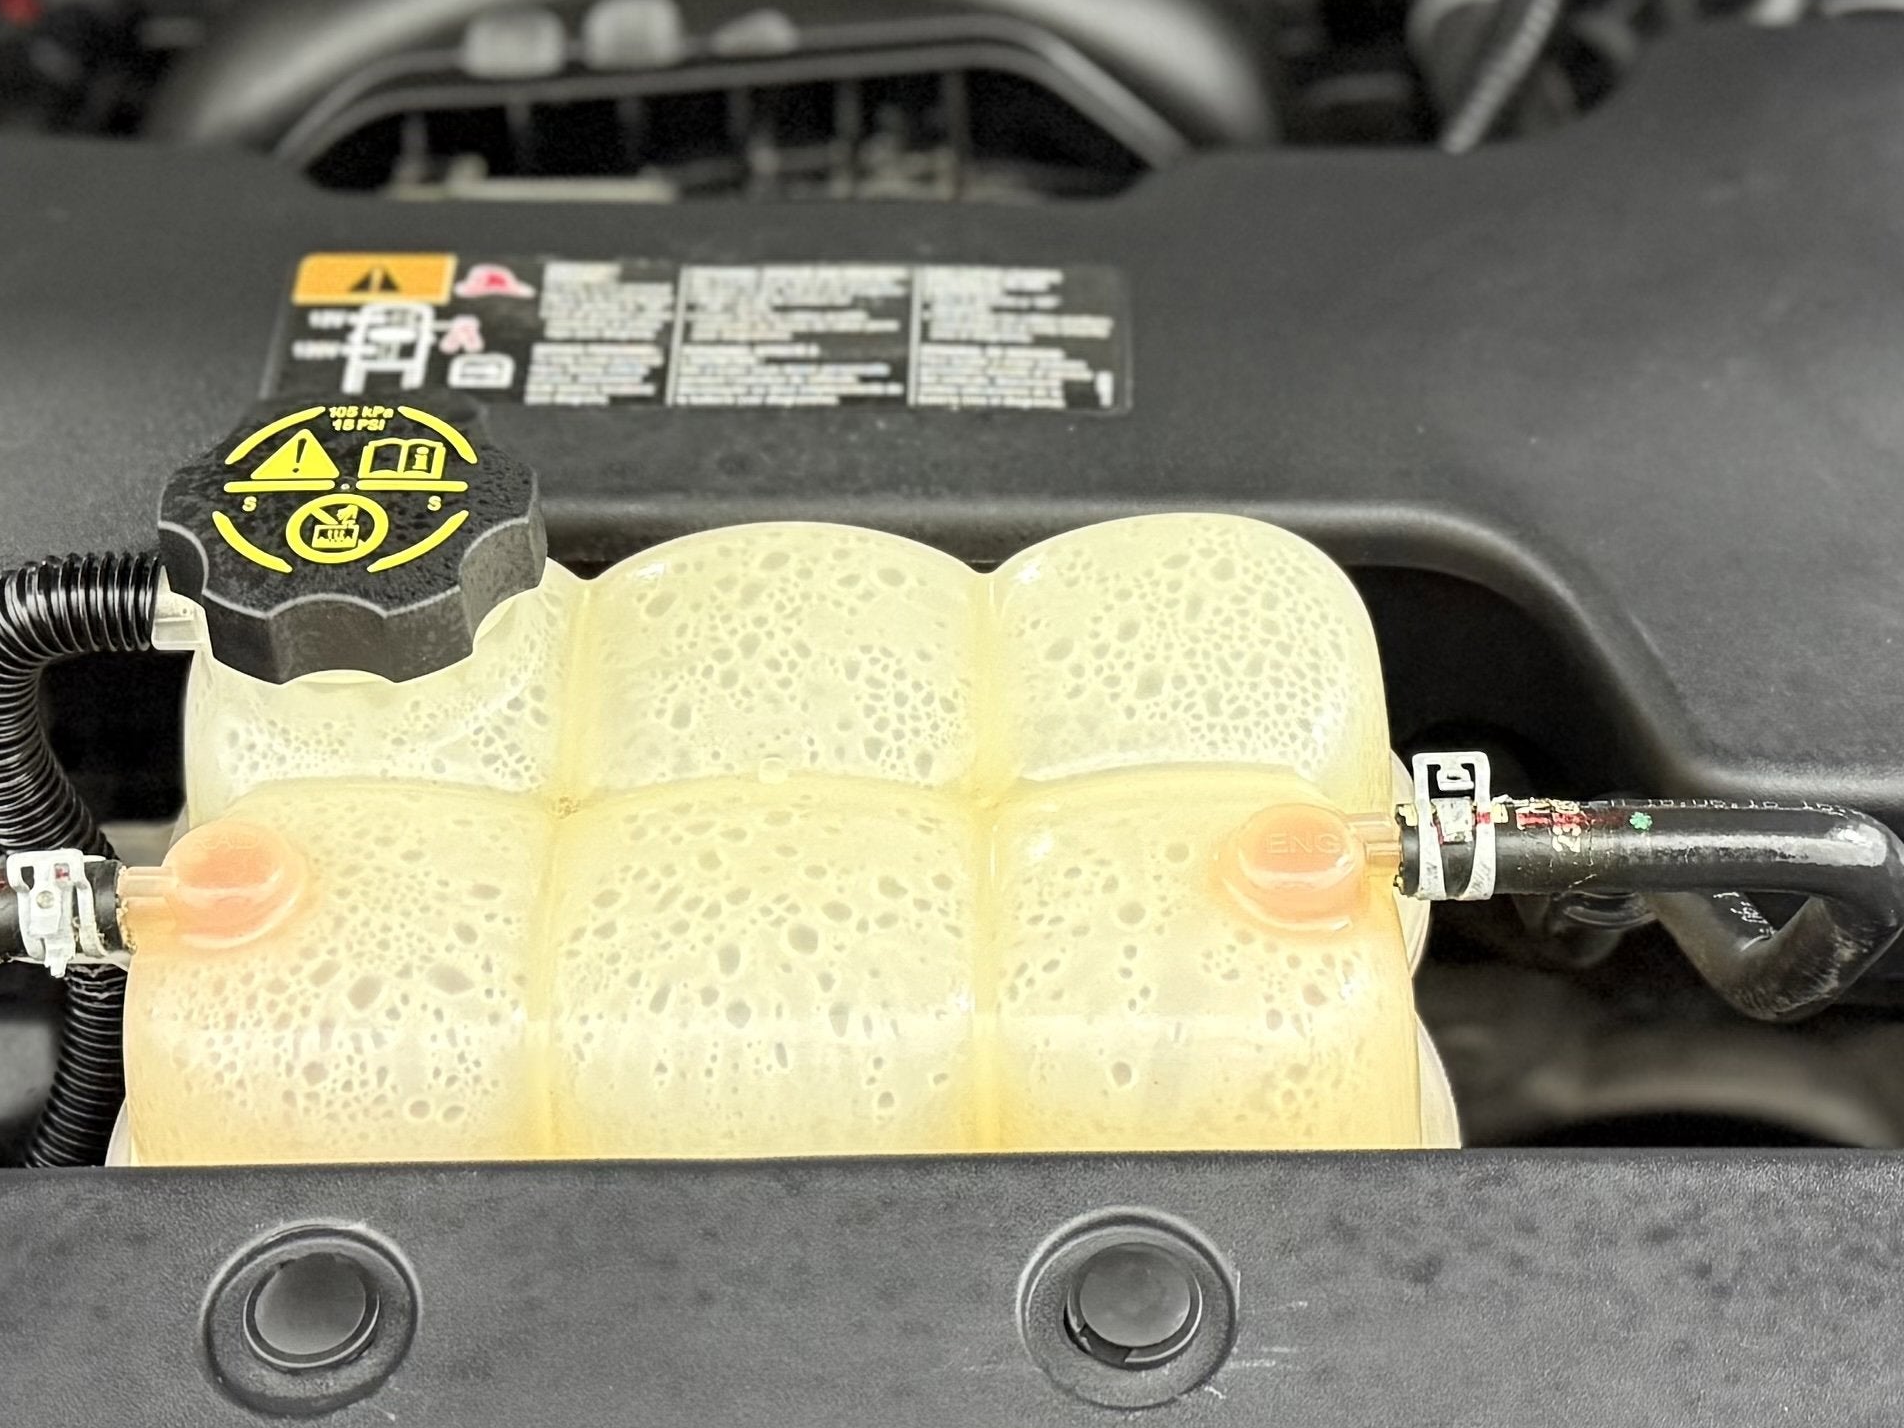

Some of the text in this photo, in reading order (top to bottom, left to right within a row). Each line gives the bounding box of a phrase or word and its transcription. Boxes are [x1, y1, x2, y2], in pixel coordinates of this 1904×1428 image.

[329, 405, 394, 419] 105 kPa
[1266, 832, 1342, 854] ENG
